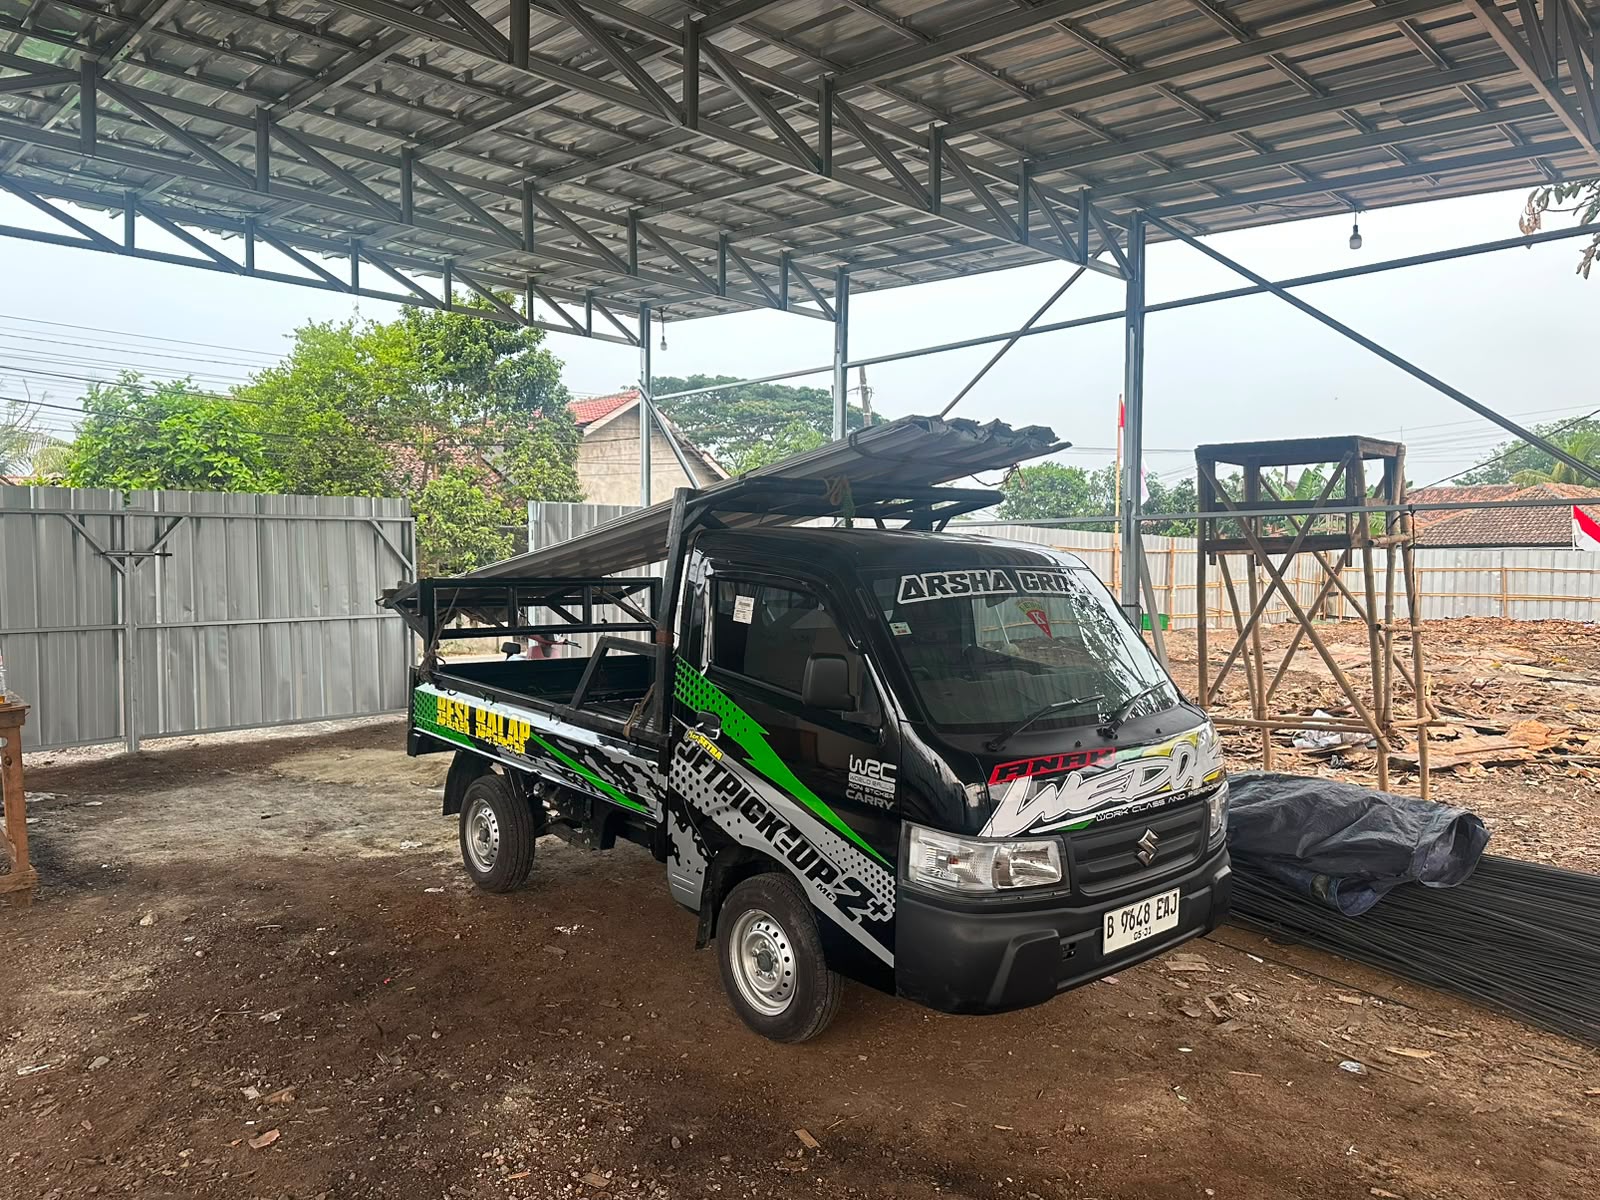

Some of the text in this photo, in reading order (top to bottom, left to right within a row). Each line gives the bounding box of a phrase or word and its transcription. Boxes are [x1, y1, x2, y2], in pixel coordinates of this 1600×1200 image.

[898, 570, 1018, 604] ARSHA
[436, 696, 531, 755] BESI BALAP
[849, 754, 897, 783] WRC
[989, 747, 1116, 785] ANAK
[845, 789, 895, 810] CARRY
[1095, 808, 1129, 822] WORK
[1131, 799, 1166, 812] CLASS
[1168, 792, 1186, 804] AND
[815, 882, 836, 901] MC
[1107, 892, 1178, 939] B 9648 EAJ
